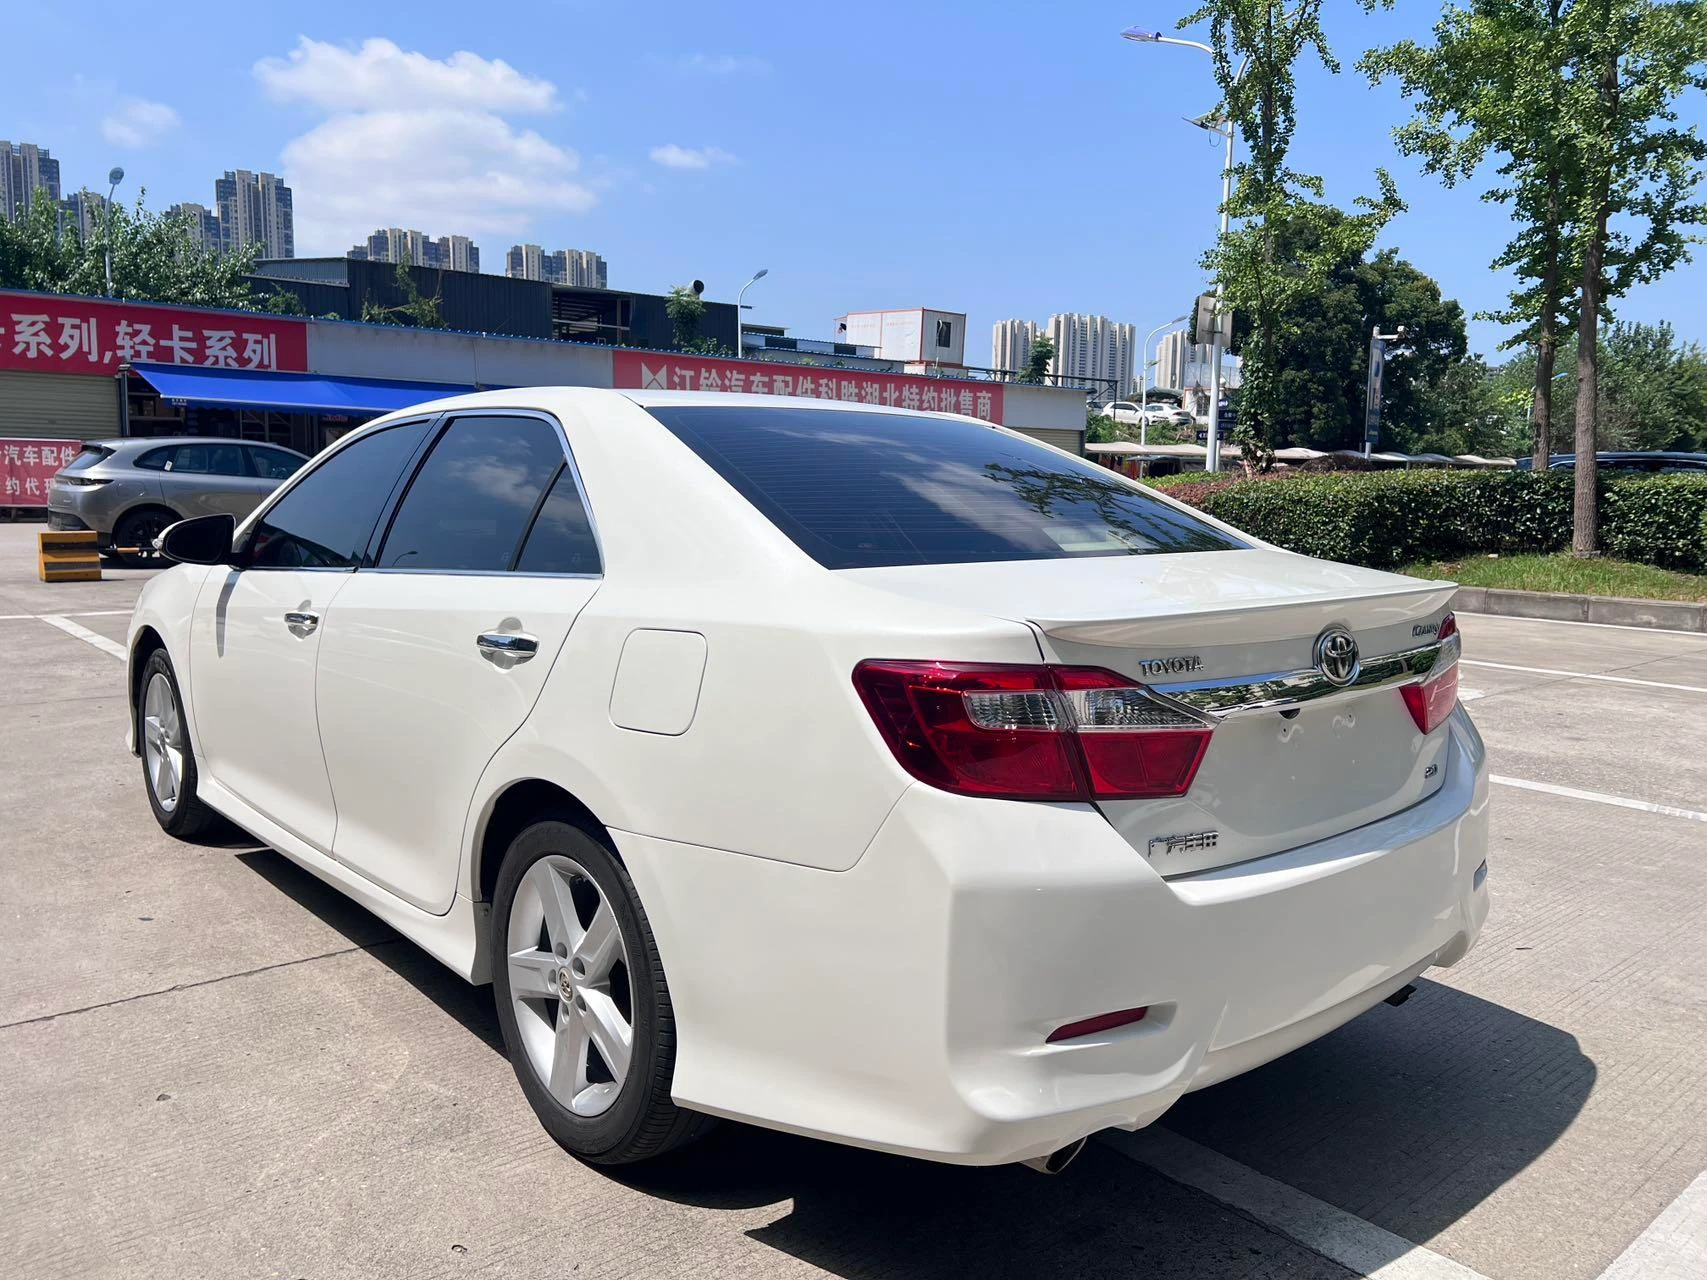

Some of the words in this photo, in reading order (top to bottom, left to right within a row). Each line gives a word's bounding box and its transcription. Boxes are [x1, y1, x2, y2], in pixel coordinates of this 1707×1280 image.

[0, 313, 278, 371] 系列,轻卡系列
[0, 444, 75, 466] 汽车配件
[1139, 655, 1204, 677] TOYOTA
